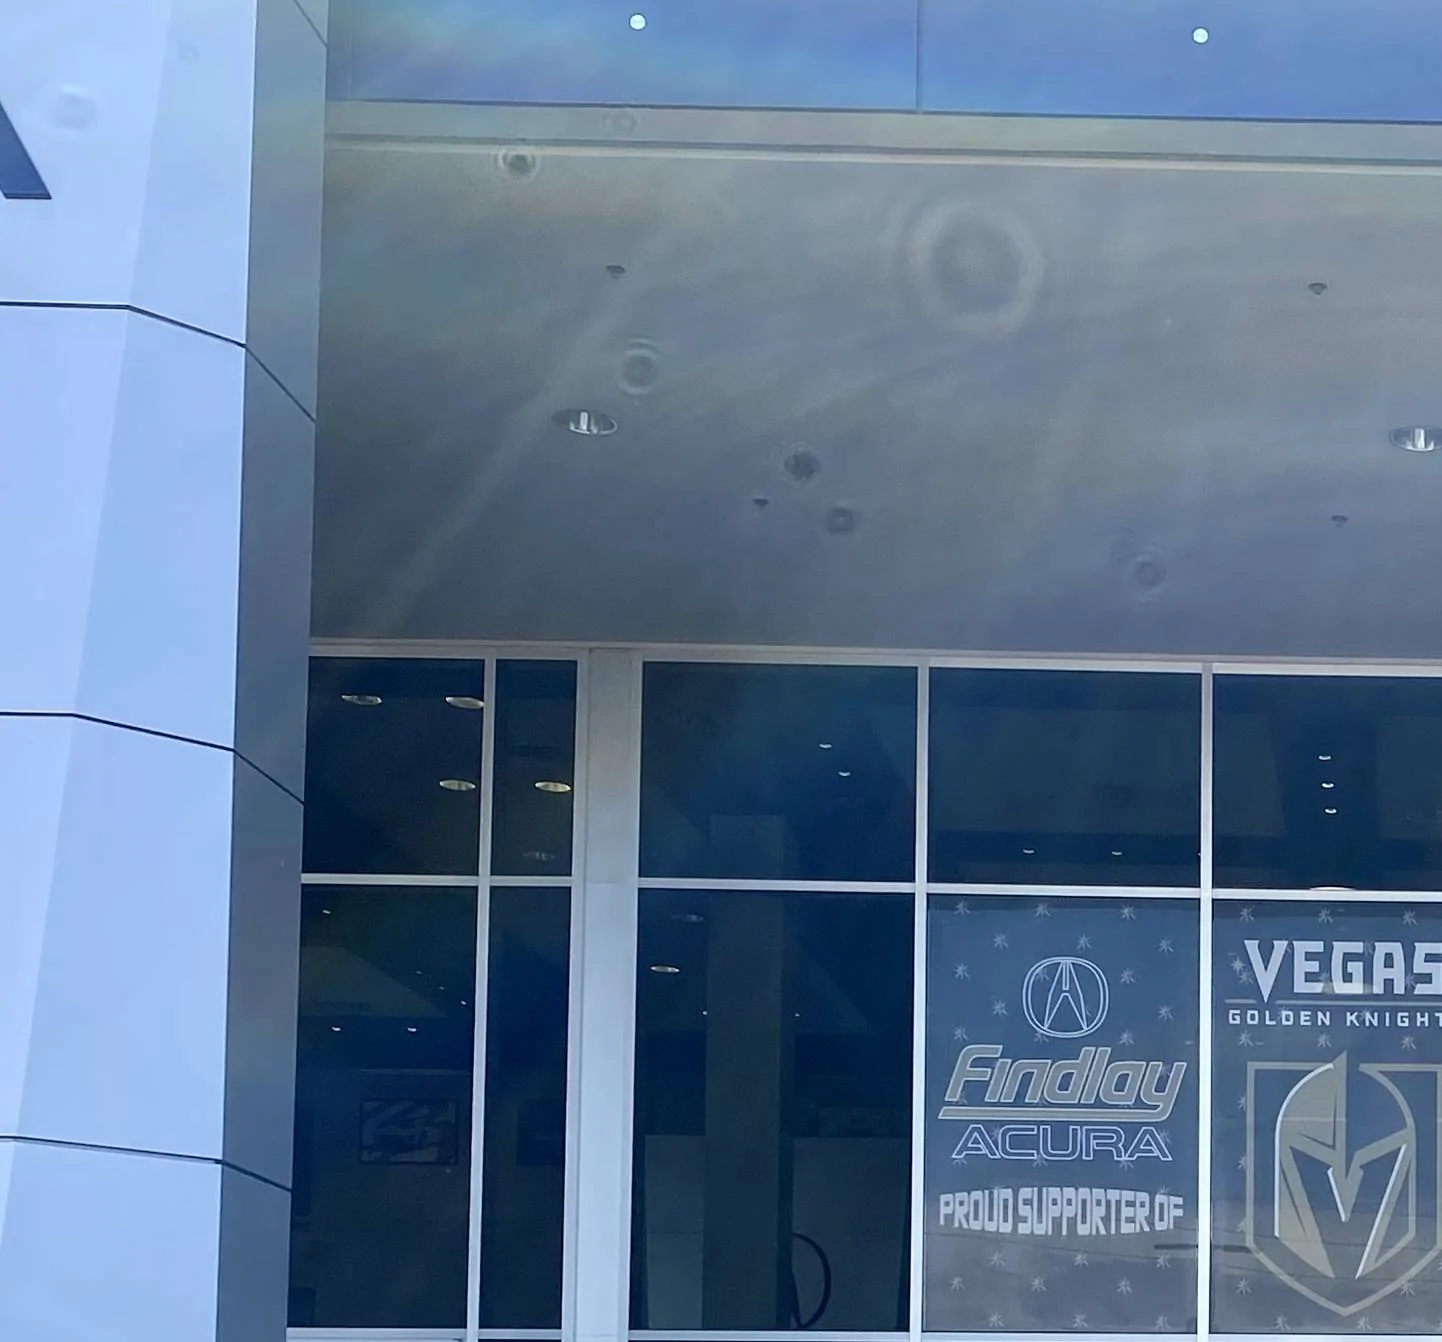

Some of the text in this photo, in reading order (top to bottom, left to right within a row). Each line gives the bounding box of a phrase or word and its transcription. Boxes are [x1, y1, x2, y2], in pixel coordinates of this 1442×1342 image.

[1228, 1009, 1331, 1027] GOLDEN
[938, 1045, 1187, 1121] Findlay
[952, 1124, 1173, 1161] ACURA
[939, 1187, 1184, 1236] PROUD SUPPORTER OF
